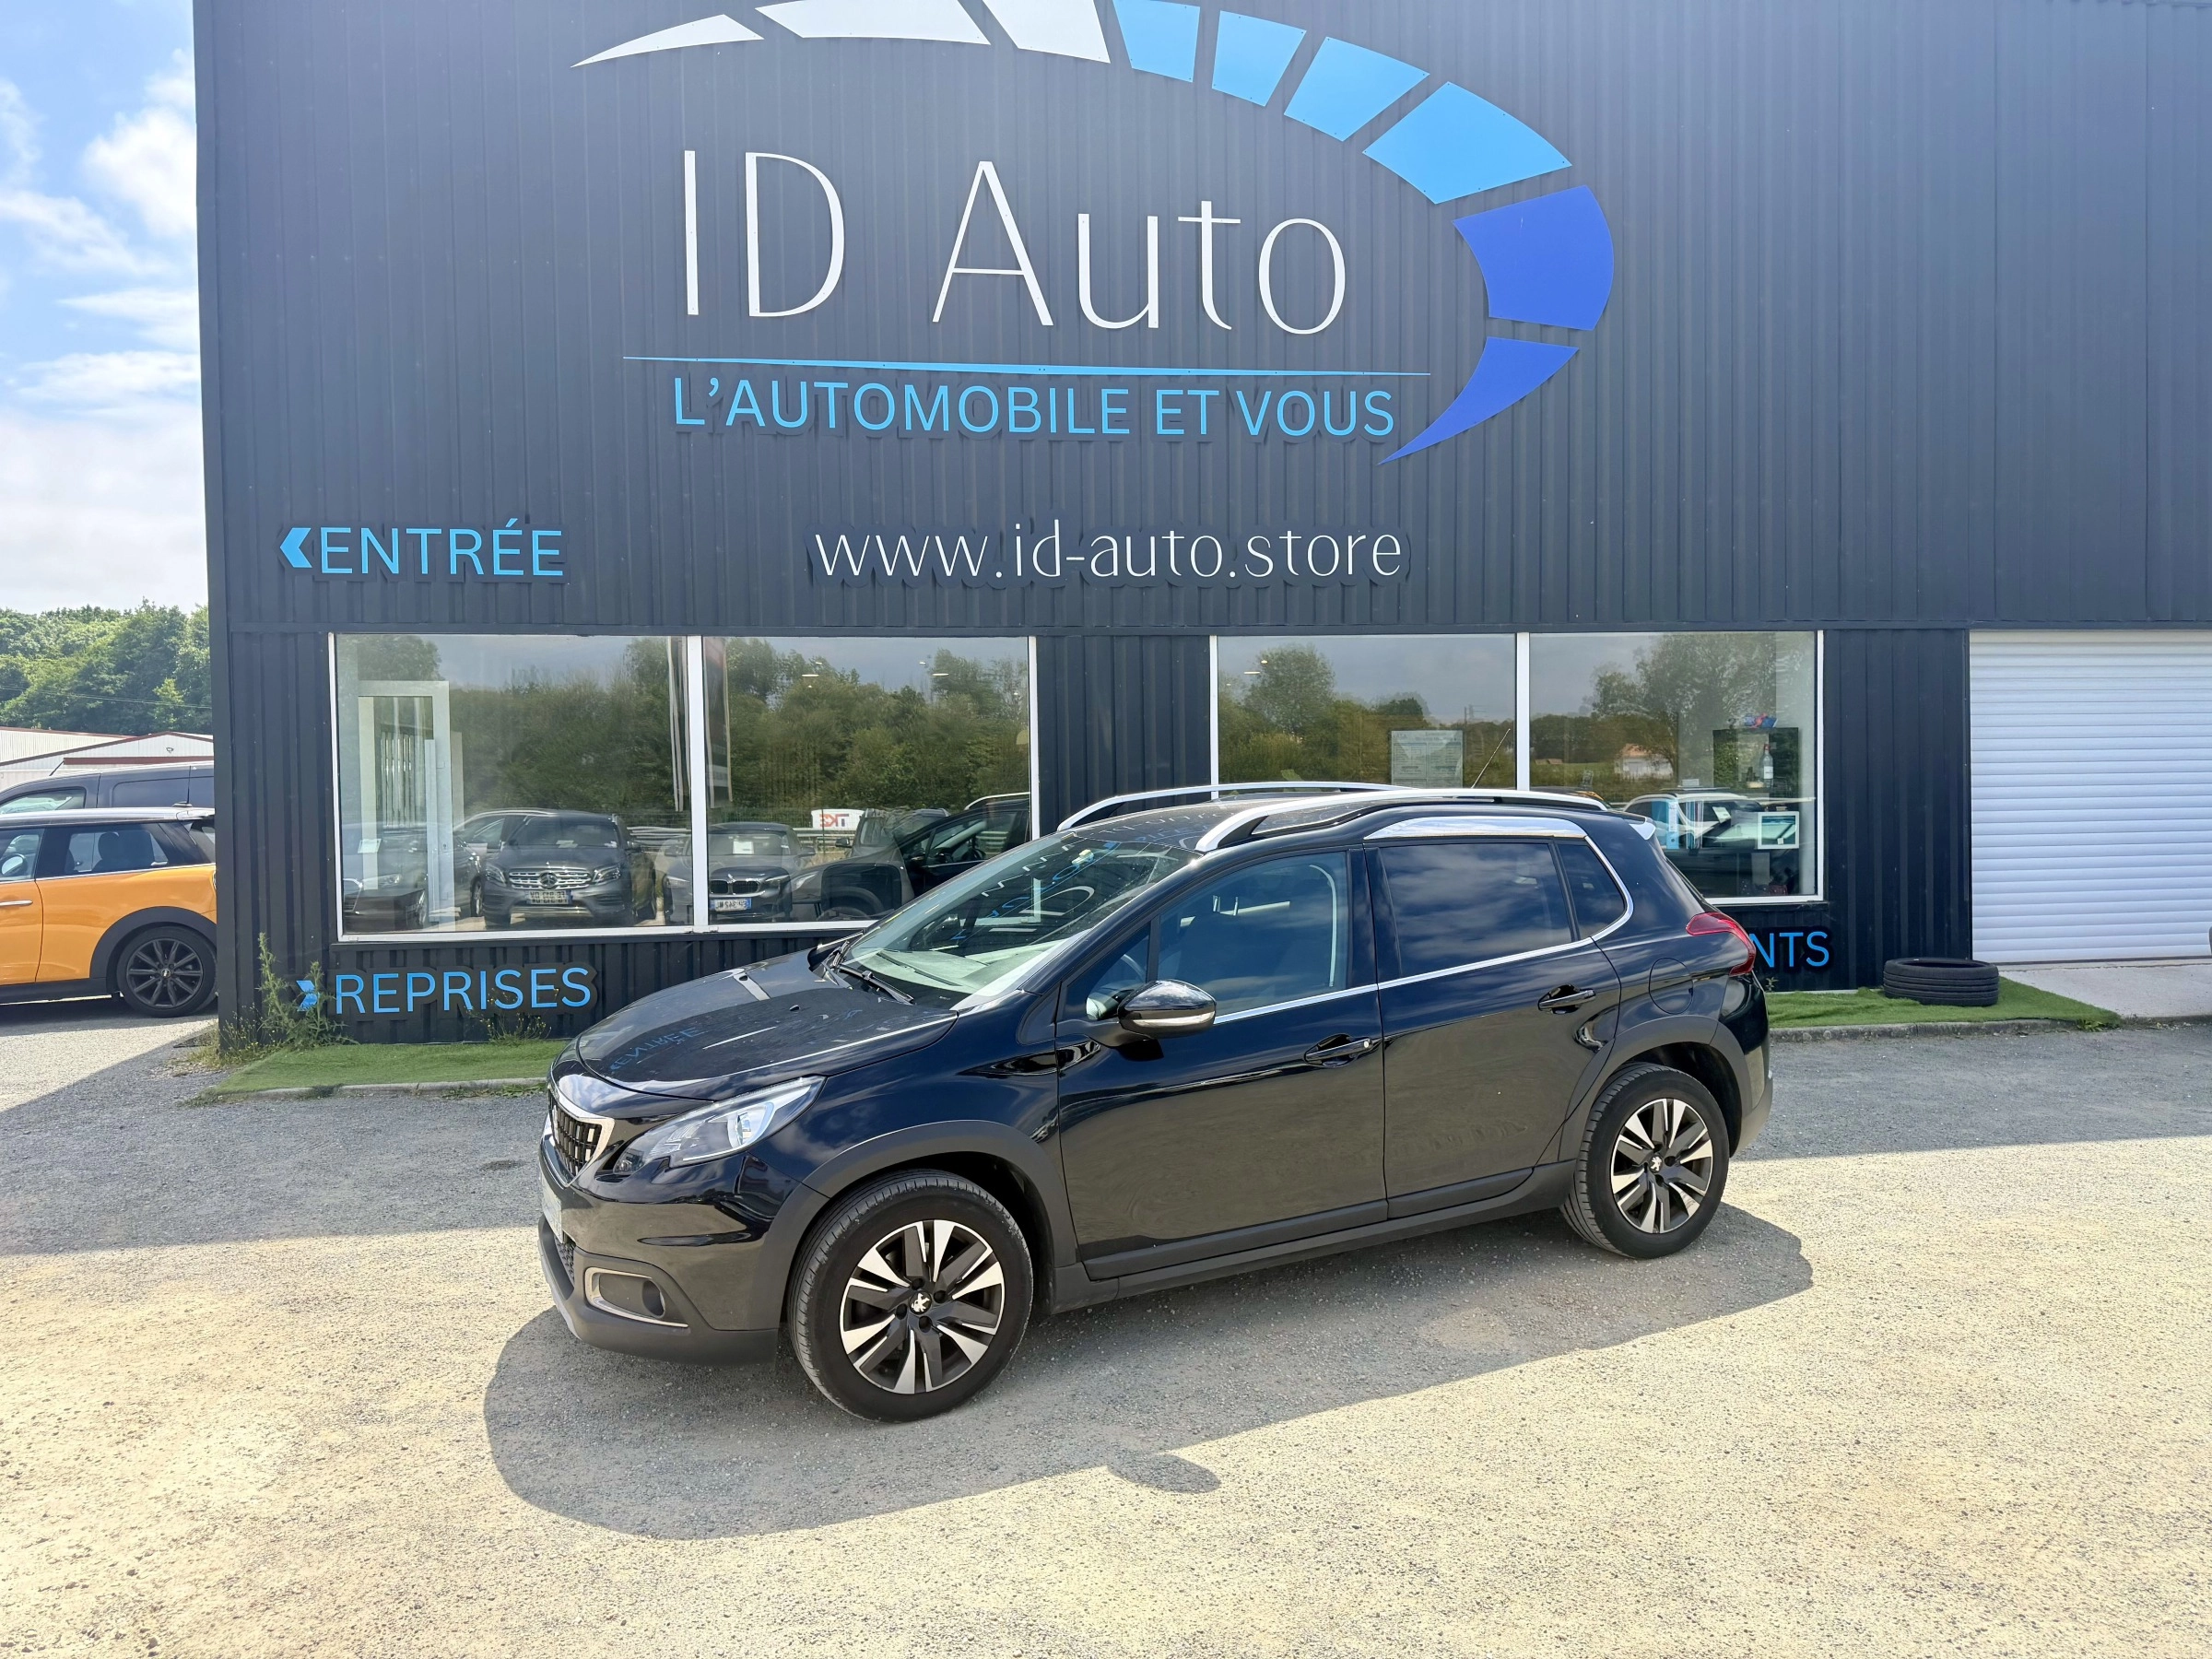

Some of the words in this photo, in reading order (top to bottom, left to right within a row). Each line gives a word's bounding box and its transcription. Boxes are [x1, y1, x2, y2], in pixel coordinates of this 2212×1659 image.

[684, 150, 845, 318] ID
[932, 160, 1347, 335] Auto
[1156, 388, 1221, 436] ET
[1235, 390, 1394, 437] VOUS
[320, 517, 564, 576] ENTRÉE
[815, 519, 1402, 578] www.id-auto.store
[335, 967, 592, 1014] REPRISES
